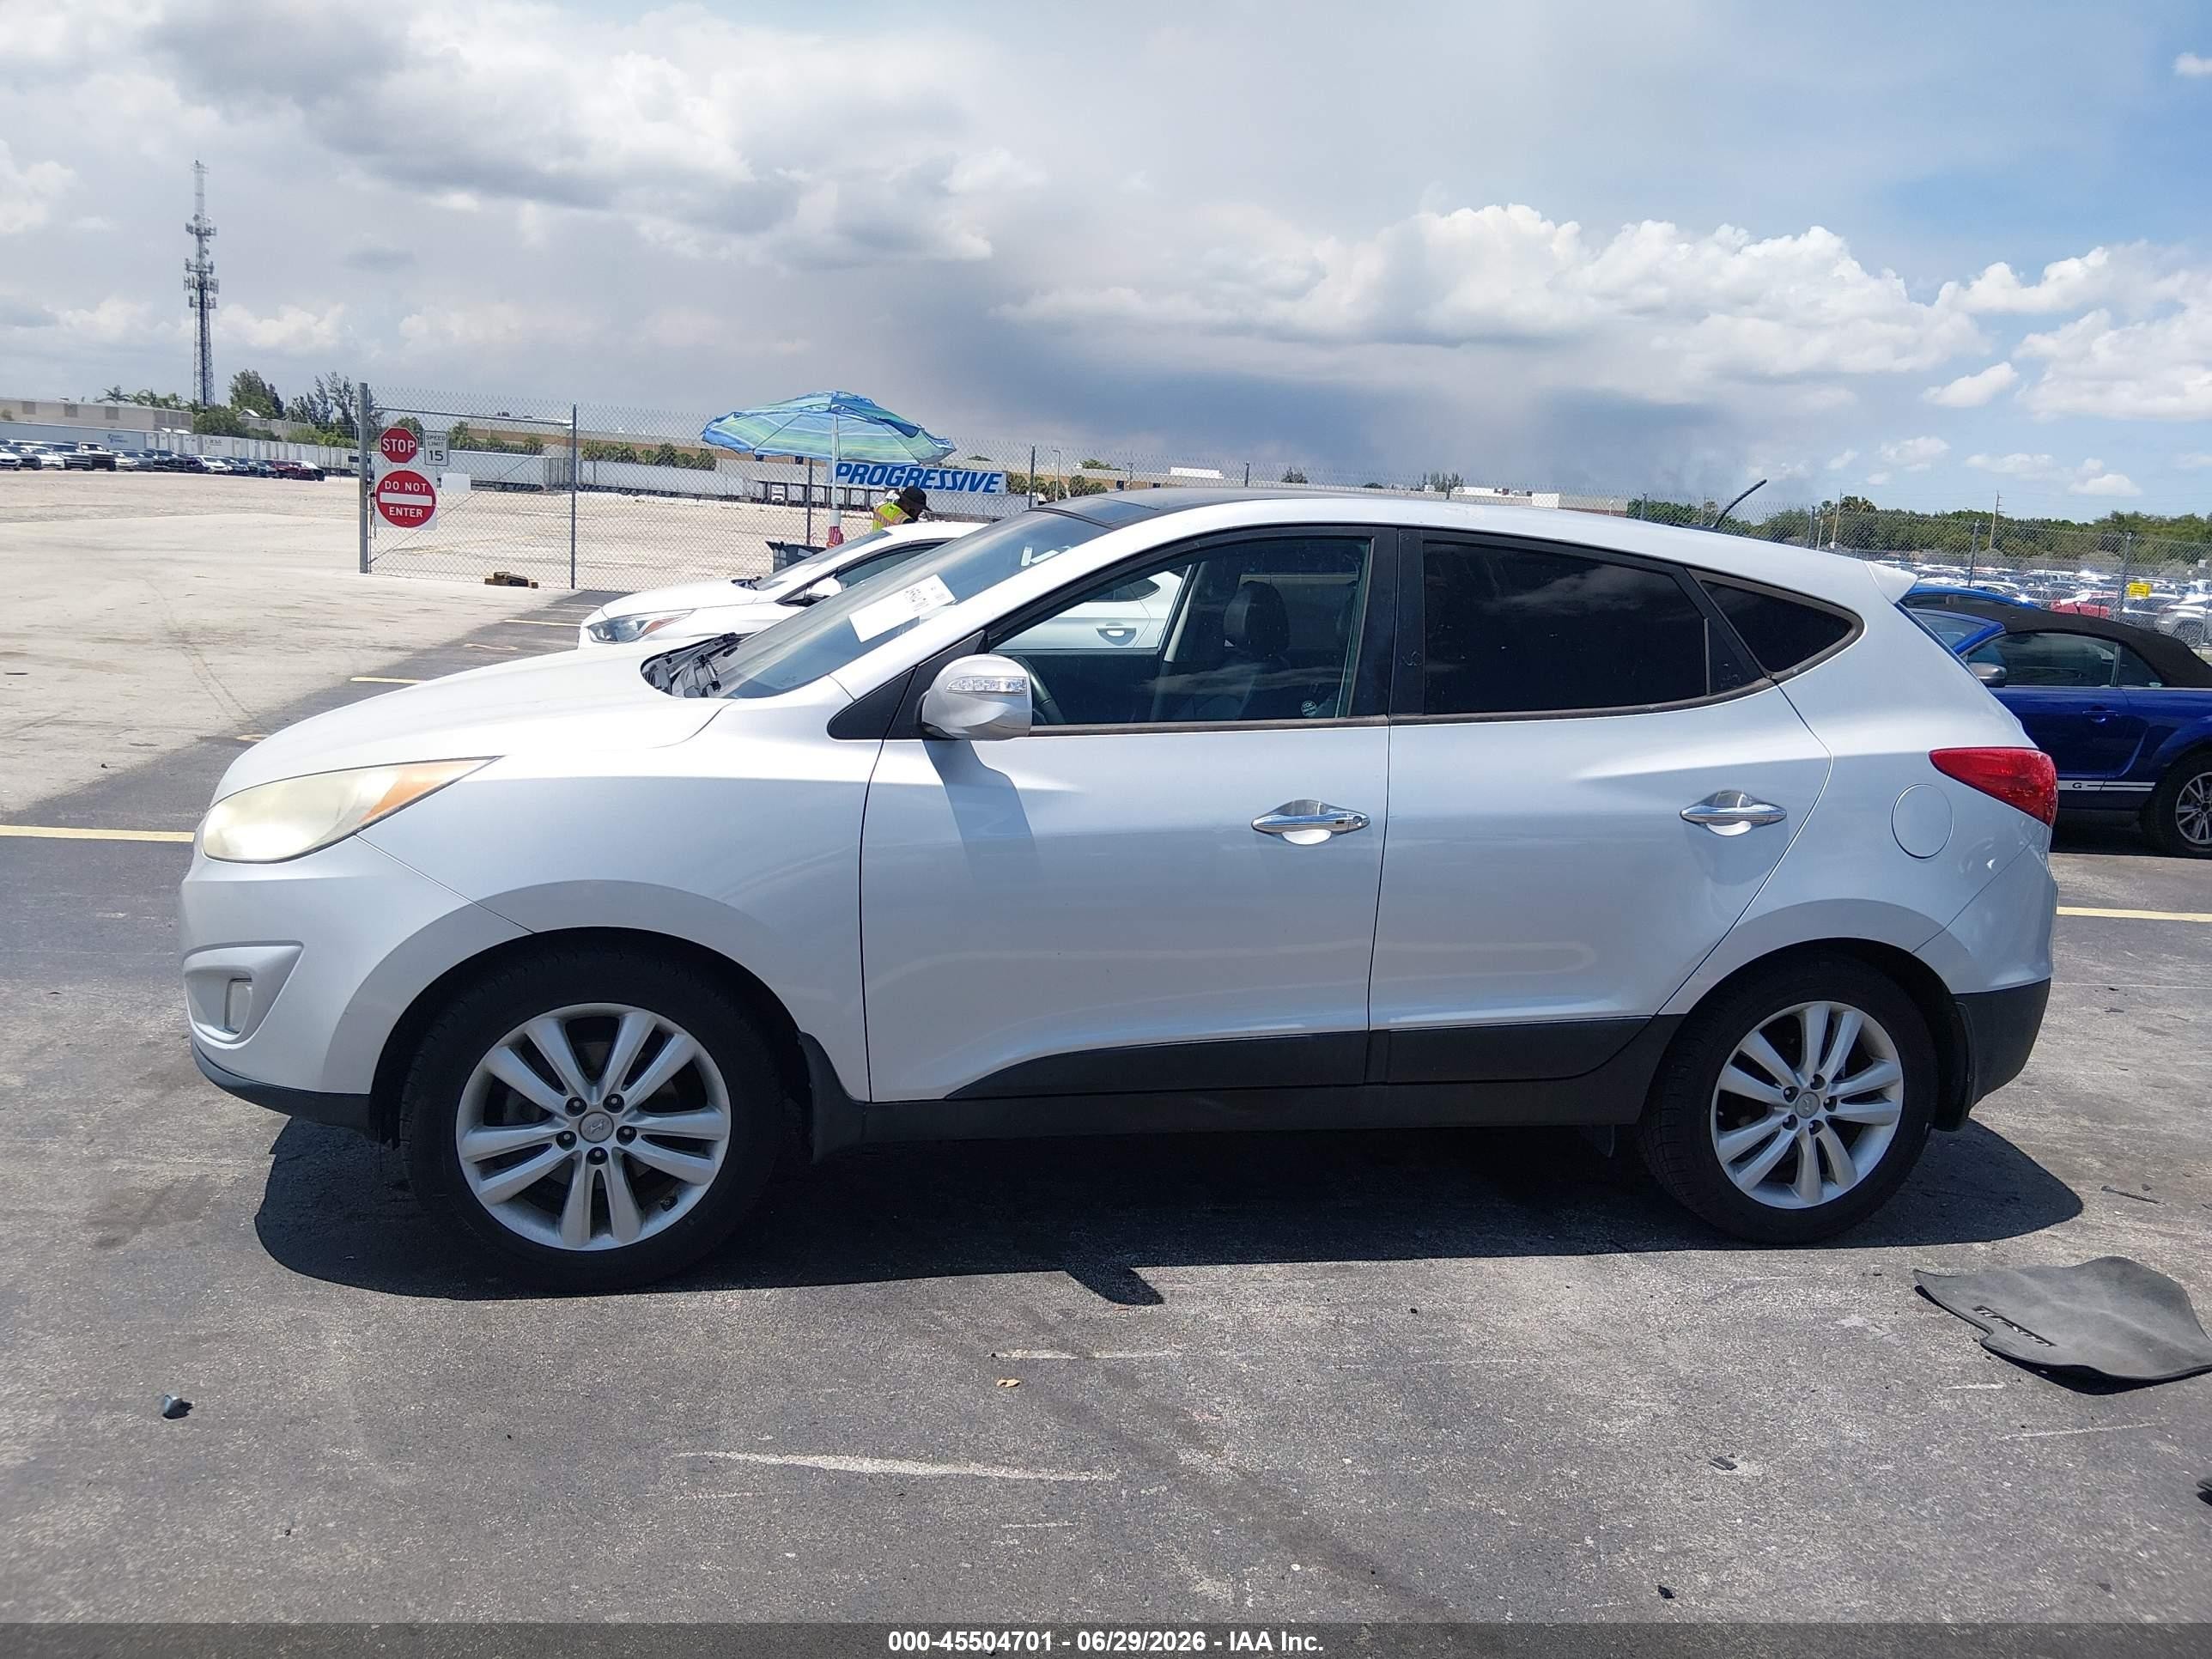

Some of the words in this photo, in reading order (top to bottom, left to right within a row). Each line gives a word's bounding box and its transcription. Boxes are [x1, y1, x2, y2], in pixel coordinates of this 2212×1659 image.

[382, 439, 416, 453] STOP
[429, 450, 444, 461] 15
[836, 463, 1003, 493] PROGRESSIVE
[385, 481, 399, 489] DO
[404, 483, 427, 492] NOT
[389, 507, 422, 518] ENTER
